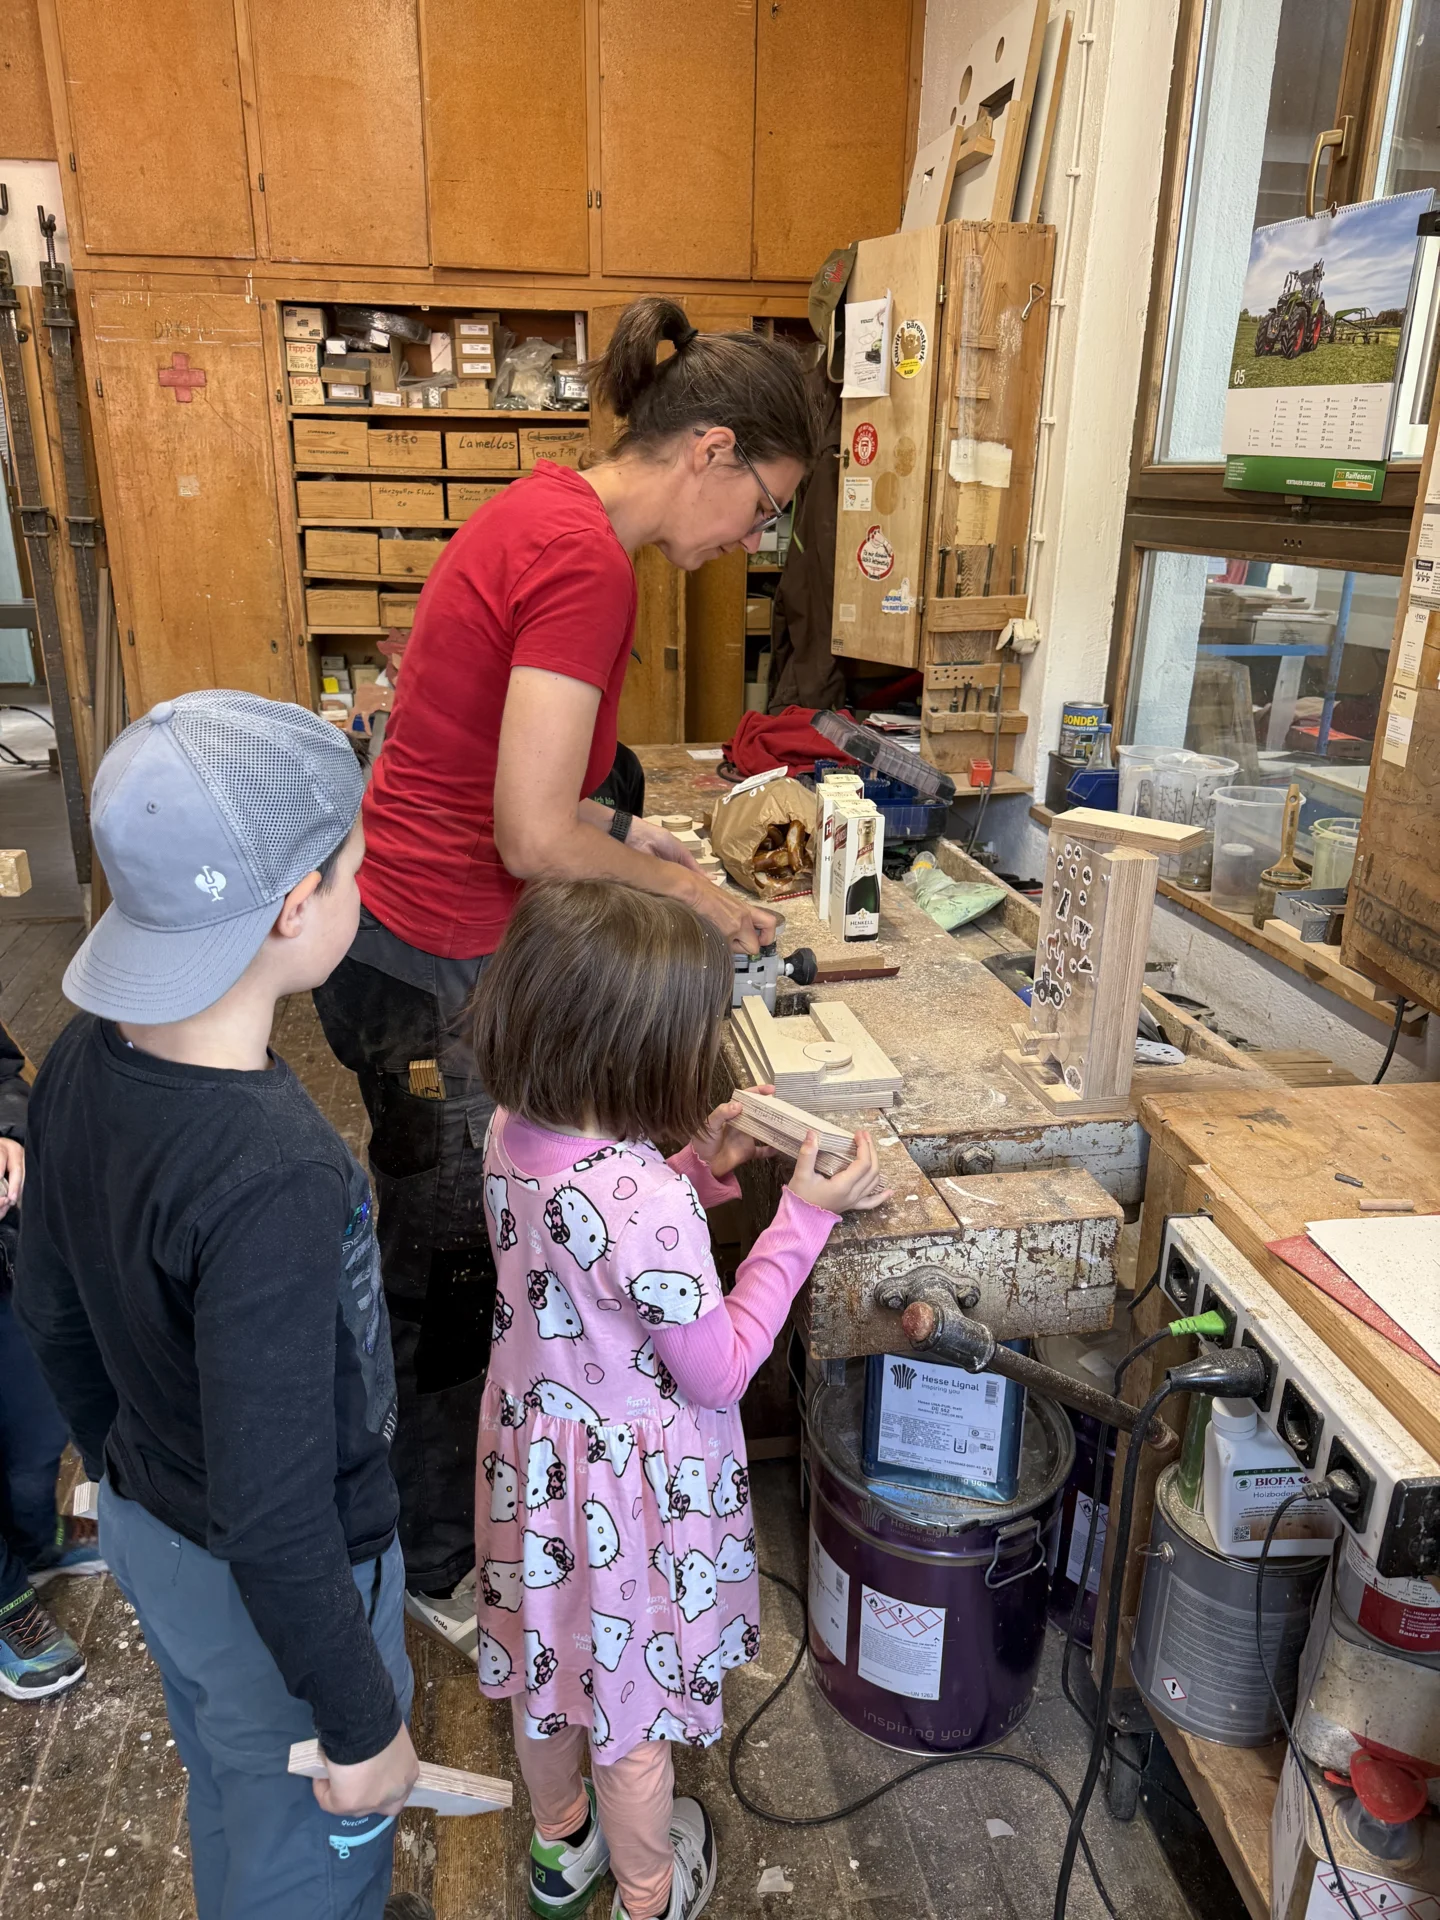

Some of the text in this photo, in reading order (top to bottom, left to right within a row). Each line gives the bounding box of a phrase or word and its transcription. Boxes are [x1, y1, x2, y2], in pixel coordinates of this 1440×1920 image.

[906, 320, 927, 362] bärenstark
[894, 332, 902, 368] Kaurit
[1233, 369, 1246, 385] 05
[459, 436, 516, 449] Lamellos
[531, 446, 557, 459] Tenso
[1345, 471, 1372, 481] Raiffeisen
[1063, 714, 1099, 727] BONDEX
[921, 1383, 948, 1394] inspiring
[922, 1374, 980, 1392] Hesse Lignal
[971, 1479, 988, 1487] you
[1255, 1476, 1296, 1486] BIOFA
[891, 1518, 923, 1533] Hesse
[1399, 1629, 1418, 1638] Basis
[863, 1708, 972, 1742] inspiring you
